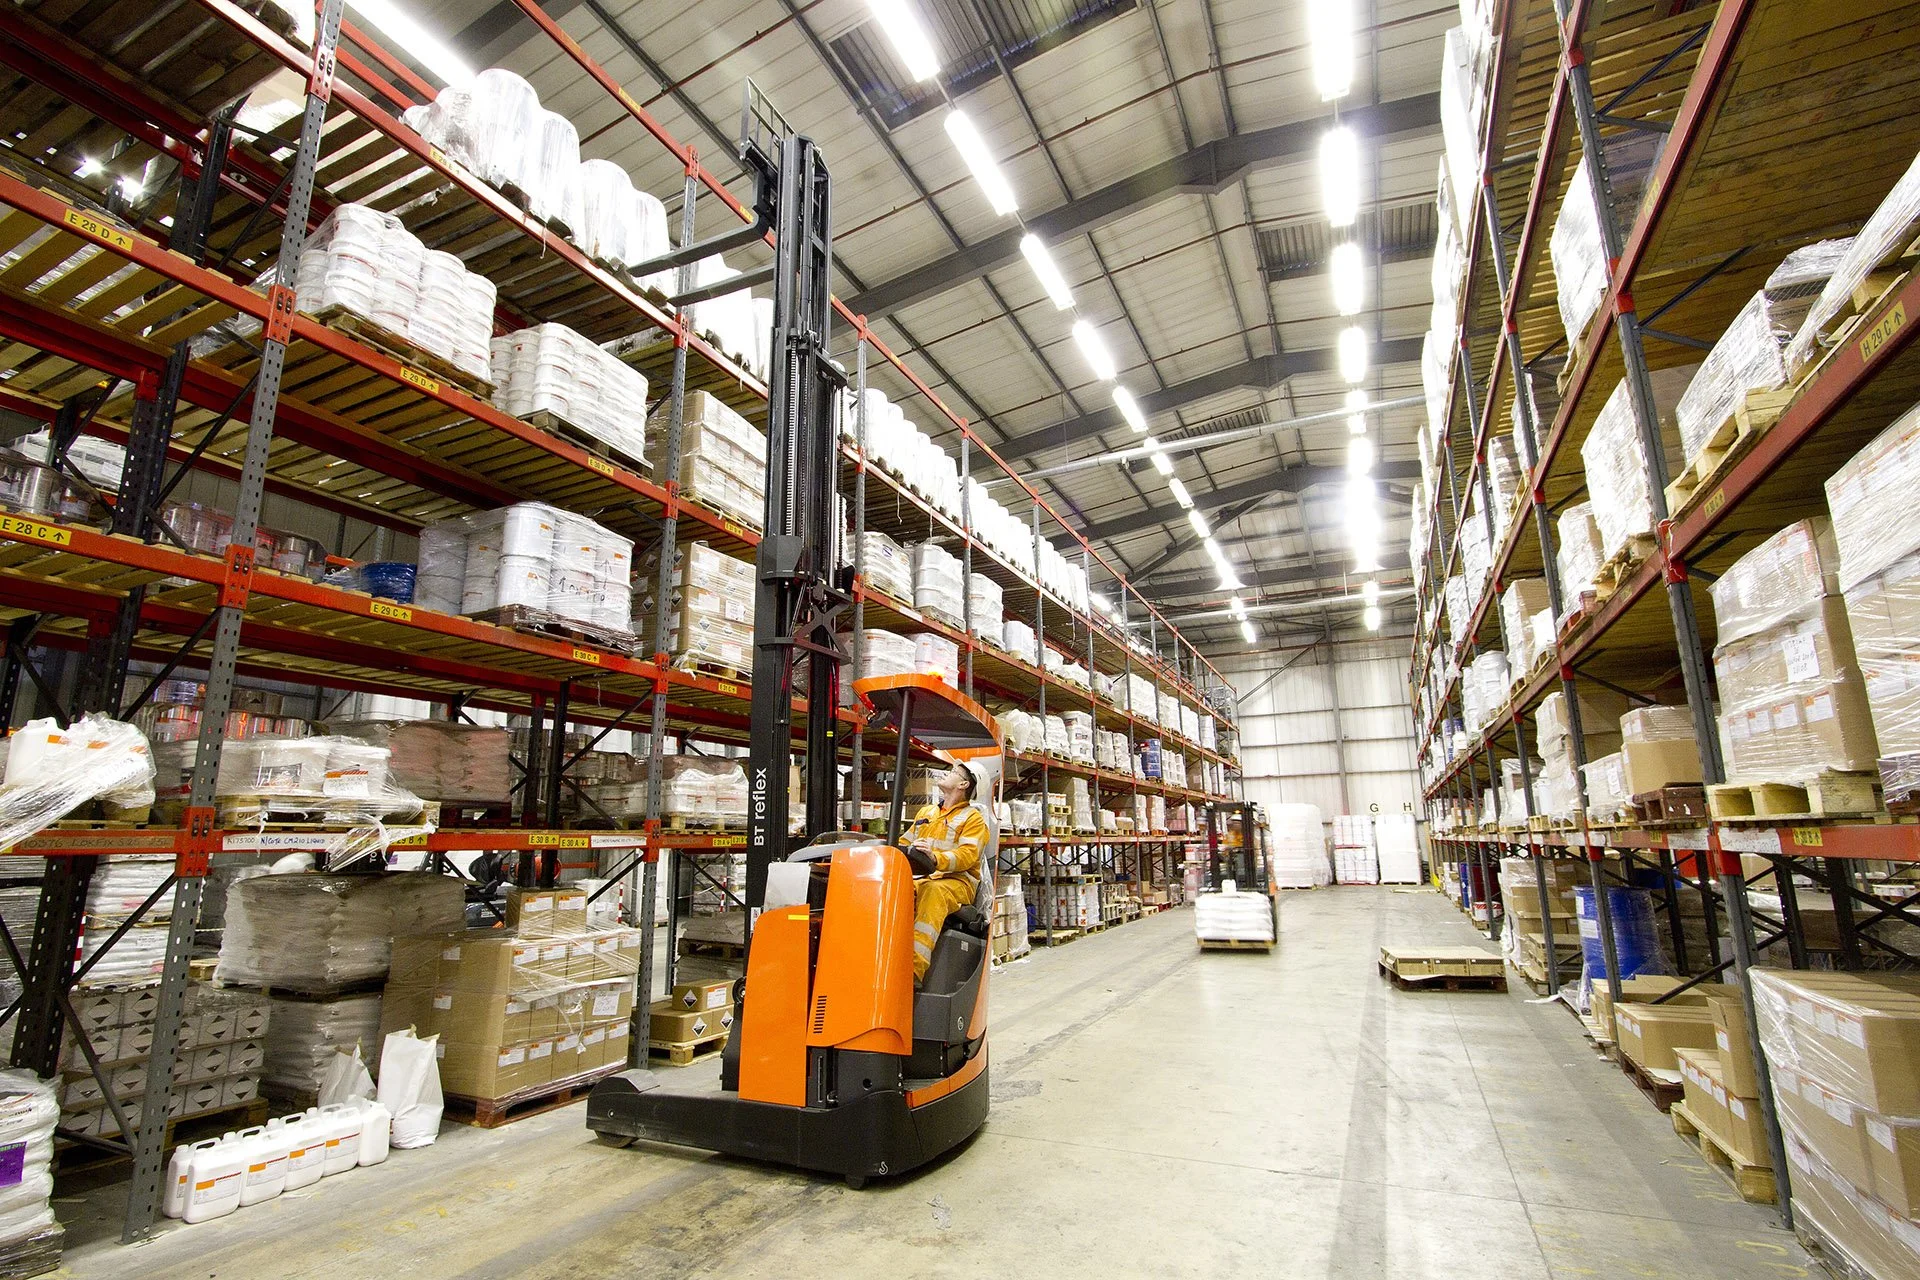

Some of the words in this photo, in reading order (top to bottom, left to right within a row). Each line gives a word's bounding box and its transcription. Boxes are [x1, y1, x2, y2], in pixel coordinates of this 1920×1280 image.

[70, 213, 78, 224] E
[81, 219, 97, 233] 28
[101, 228, 110, 238] D
[1862, 340, 1871, 357] H
[1871, 328, 1883, 349] 29
[1883, 319, 1891, 336] C
[402, 370, 407, 378] E
[410, 373, 419, 382] 29
[420, 378, 427, 386] D
[594, 461, 600, 469] 30
[2, 518, 11, 530] E
[15, 521, 33, 535] 28
[38, 527, 47, 538] C
[373, 604, 379, 612] E
[380, 605, 391, 615] 29
[392, 608, 399, 617] C
[580, 651, 586, 660] 30
[752, 767, 766, 820] reflex
[1370, 802, 1379, 813] G
[1403, 802, 1412, 811] H
[561, 839, 566, 847] E
[566, 839, 574, 847] 30
[575, 839, 579, 847] A
[754, 825, 765, 846] BT
